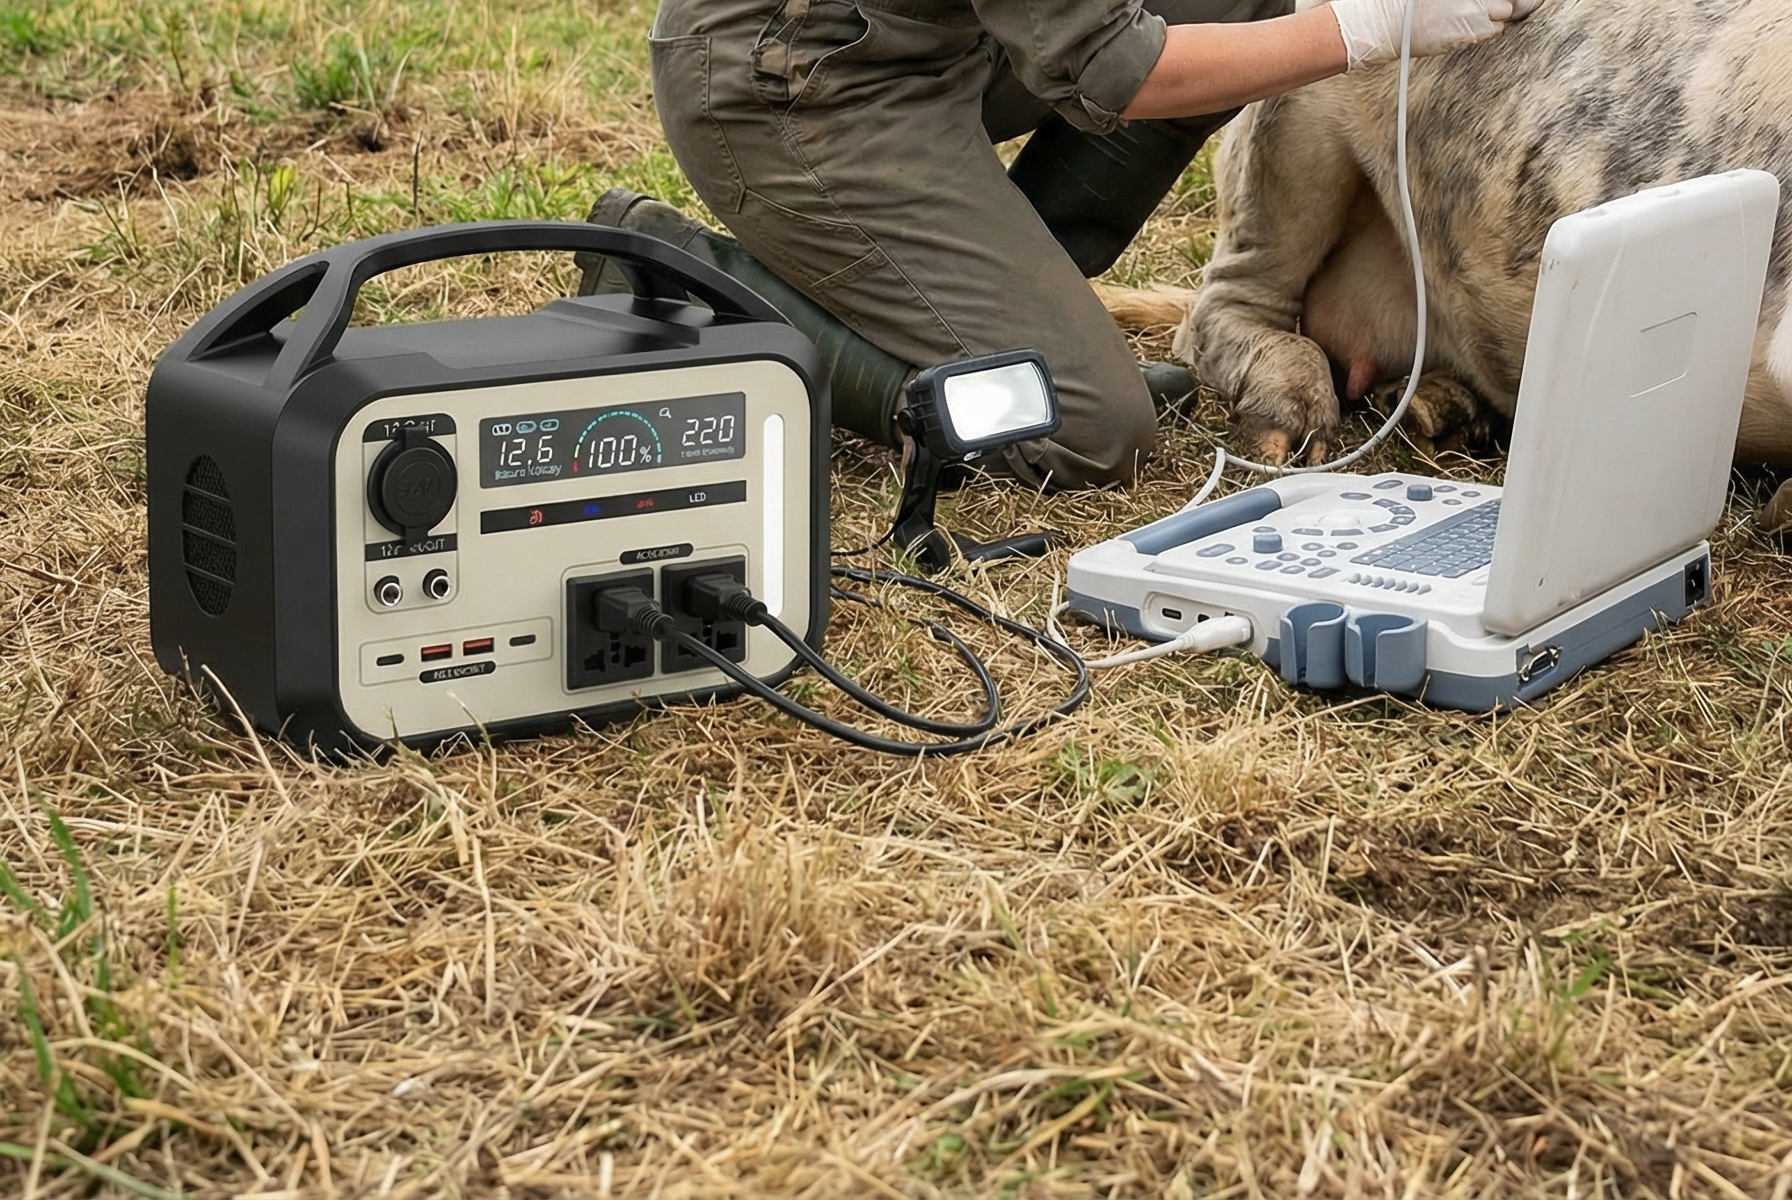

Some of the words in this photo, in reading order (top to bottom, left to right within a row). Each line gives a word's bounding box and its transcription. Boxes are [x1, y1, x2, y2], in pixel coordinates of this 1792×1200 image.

[682, 415, 735, 446] 220
[500, 435, 553, 467] 12.6
[689, 492, 707, 503] LED
